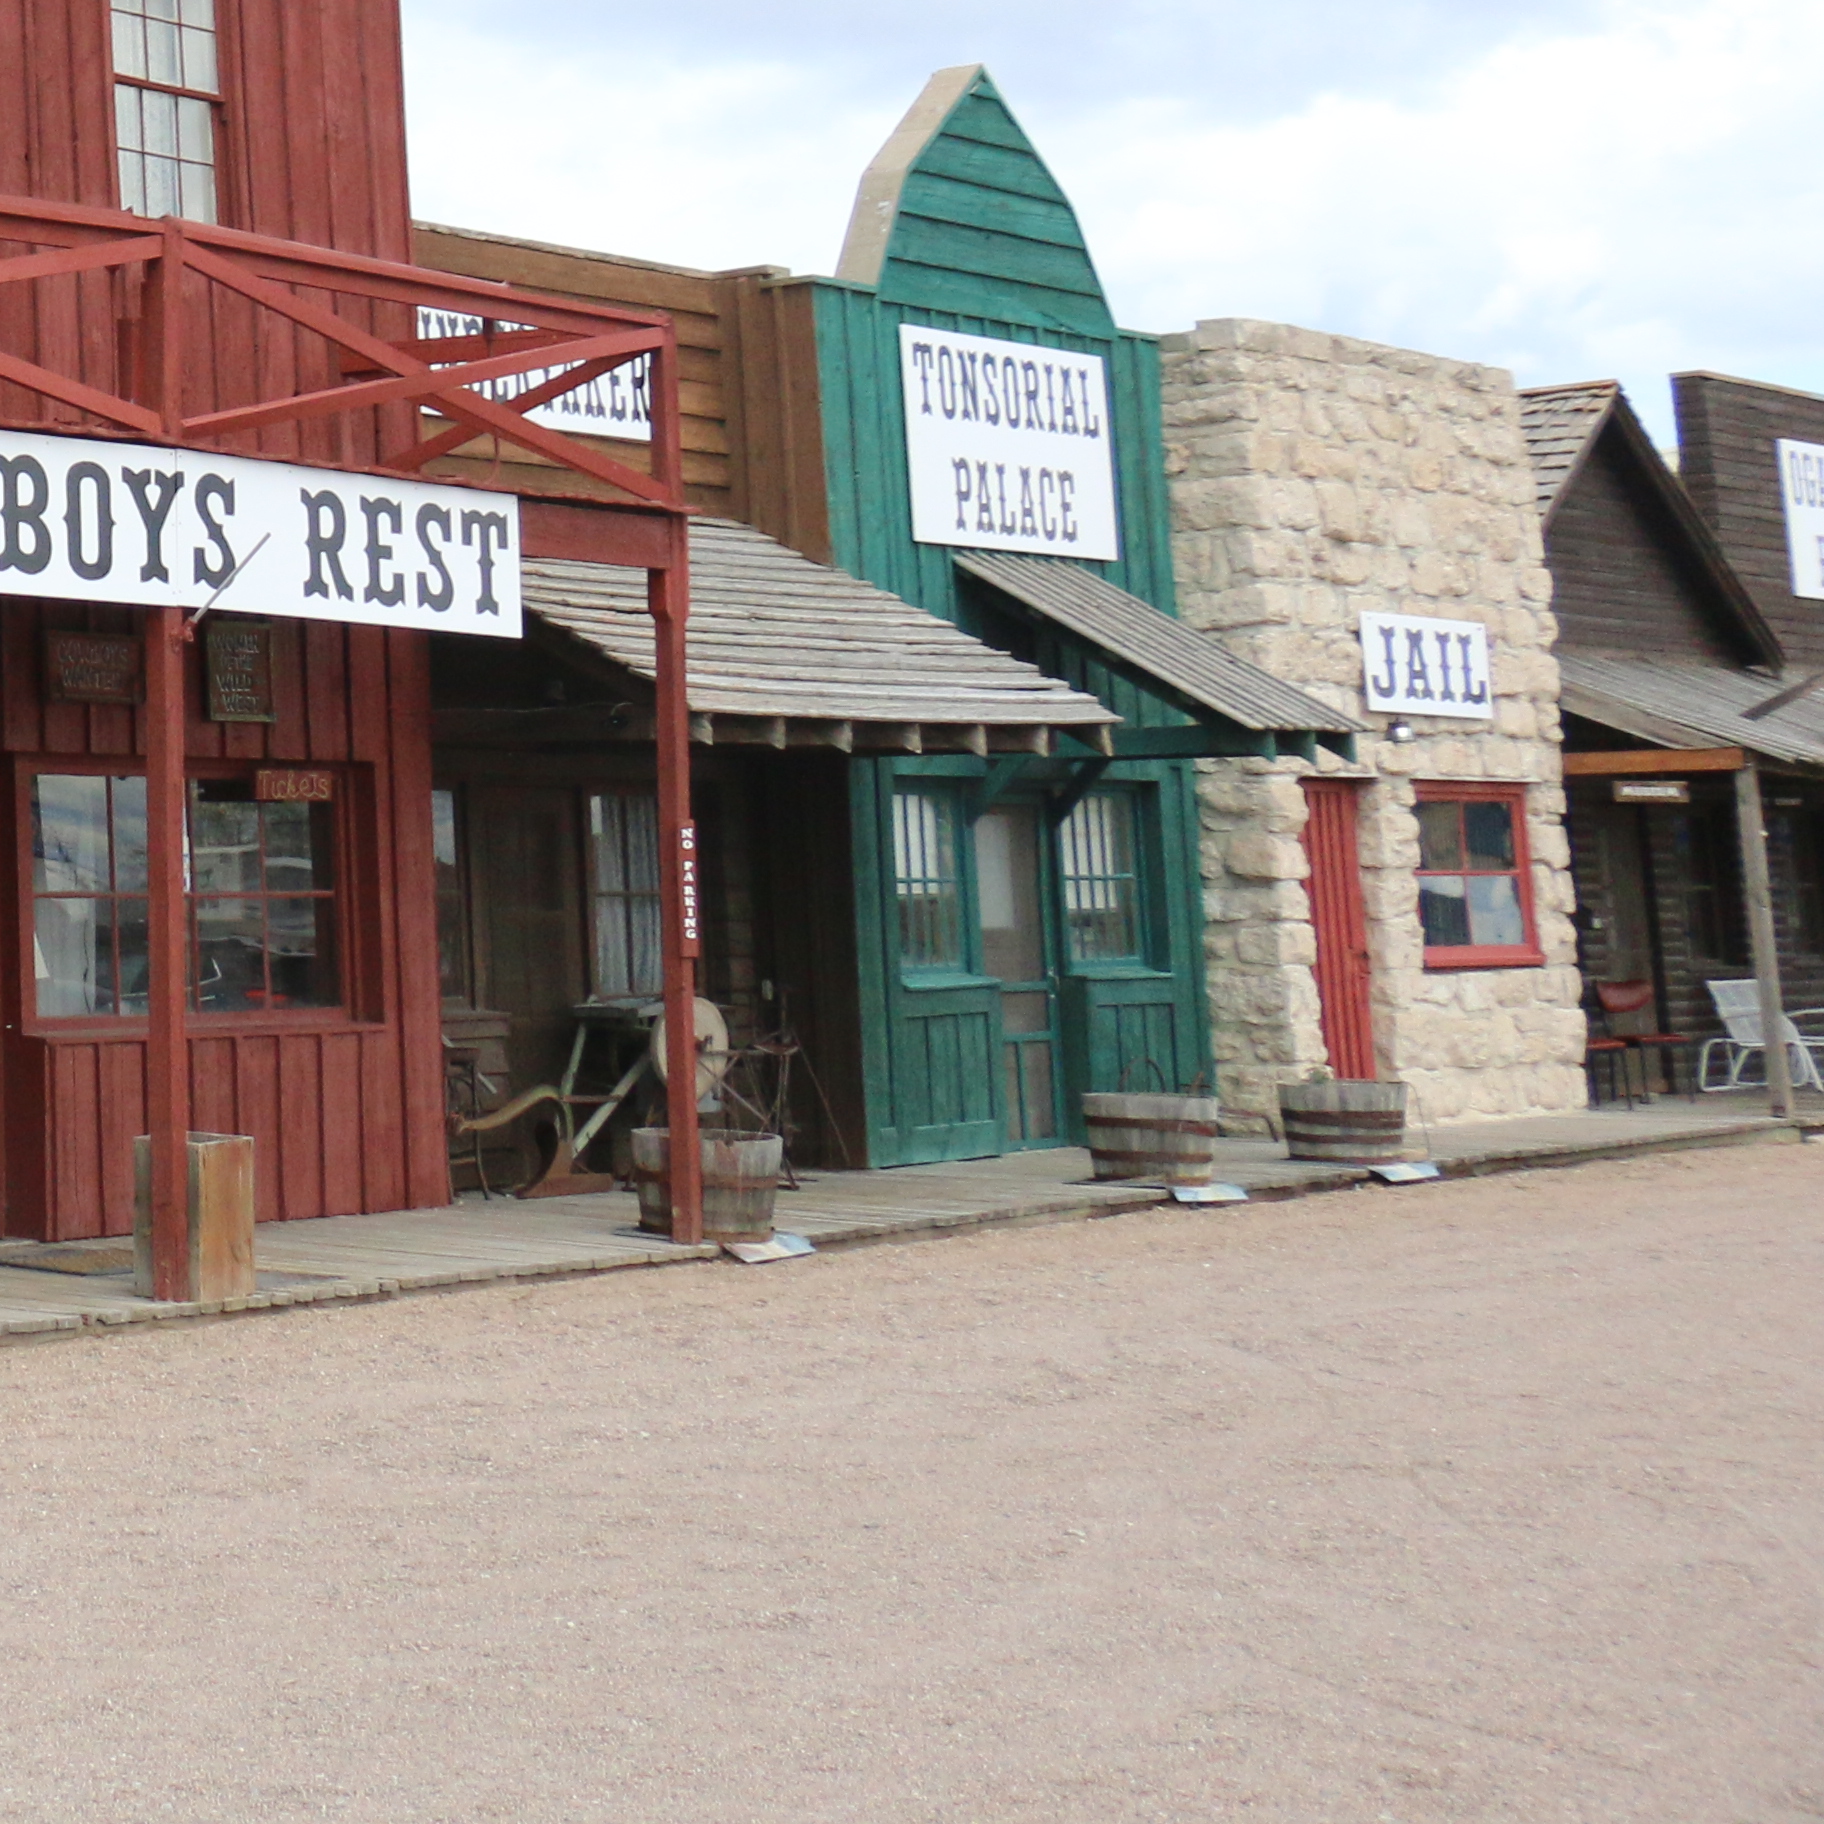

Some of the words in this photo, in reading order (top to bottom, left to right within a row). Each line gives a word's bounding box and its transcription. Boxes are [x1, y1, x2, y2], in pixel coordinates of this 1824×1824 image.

[420, 308, 653, 424] DEAKER
[912, 341, 1100, 439] TONSORIAL
[952, 457, 1079, 543] PALACE
[300, 486, 509, 616] REST
[1371, 625, 1489, 705] JAIL
[258, 770, 329, 799] Tickets
[680, 827, 694, 850] NO
[683, 860, 697, 939] PARKING
